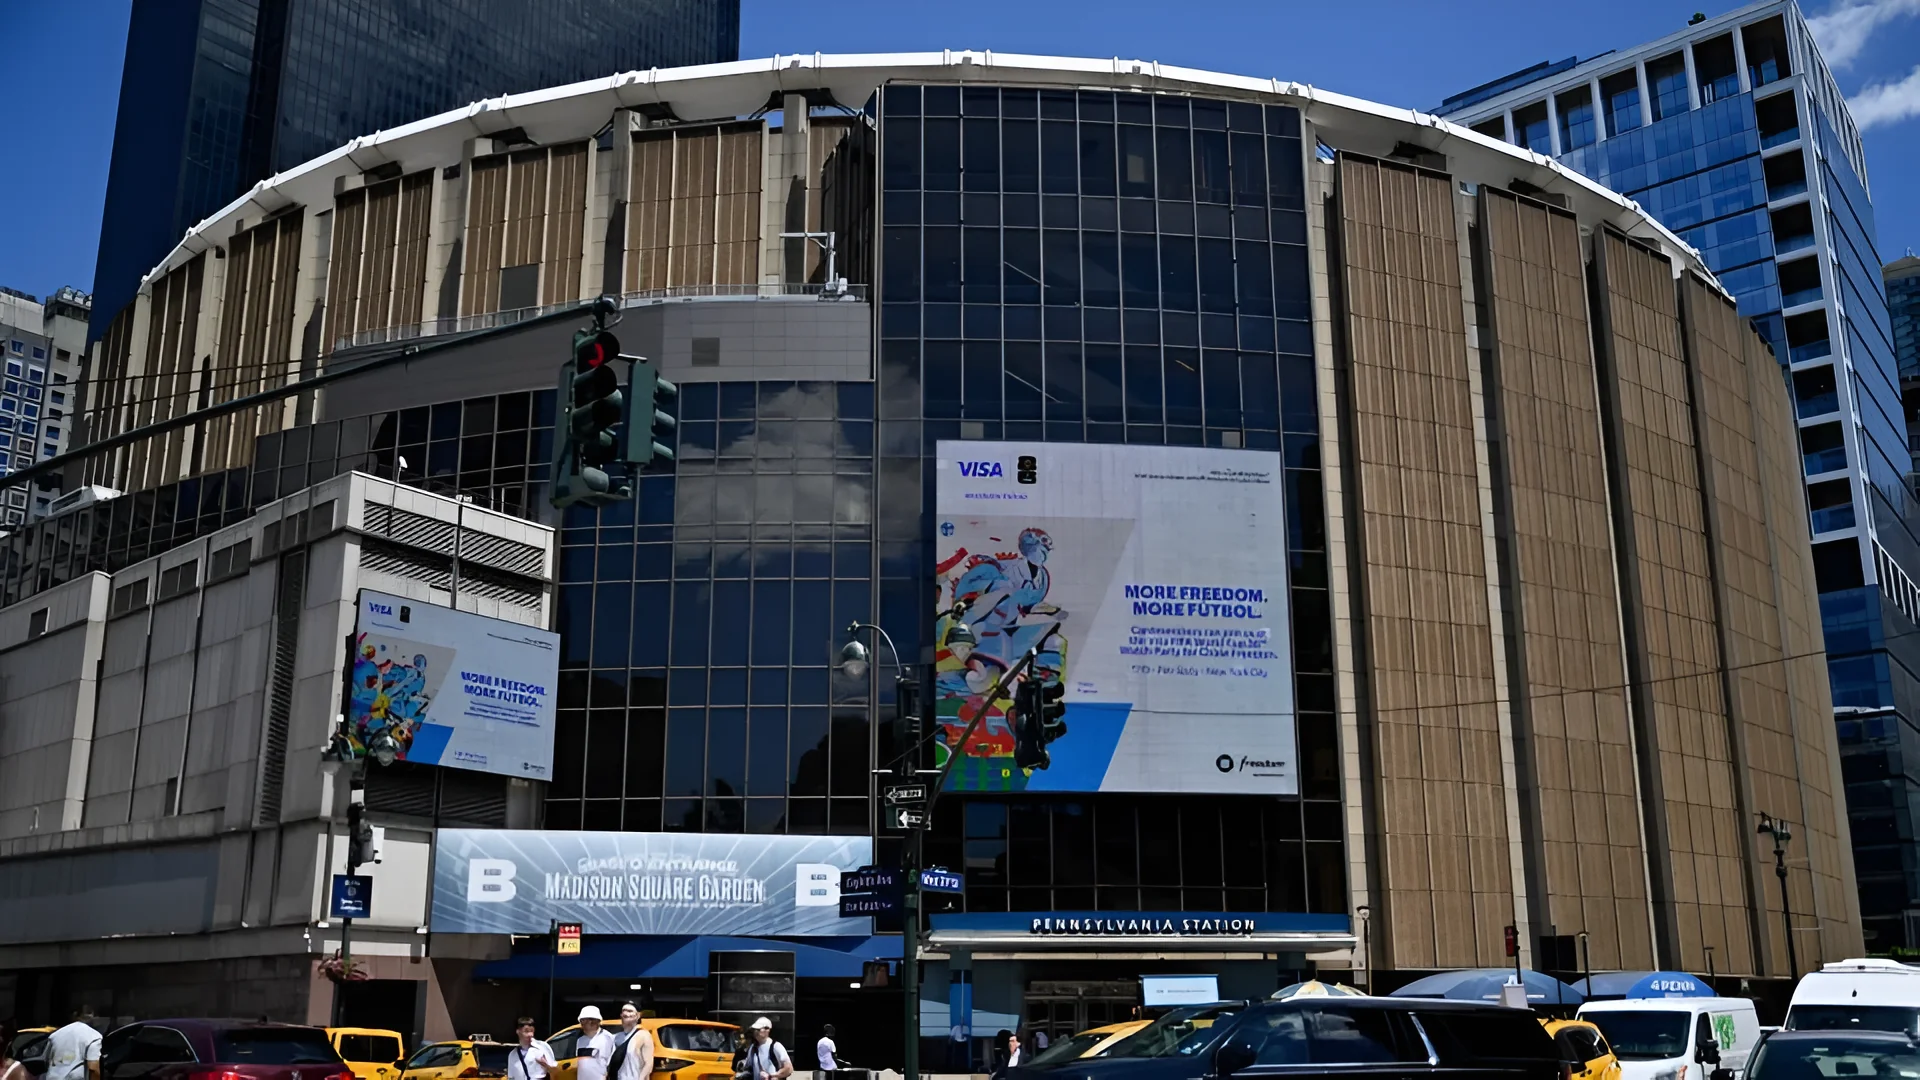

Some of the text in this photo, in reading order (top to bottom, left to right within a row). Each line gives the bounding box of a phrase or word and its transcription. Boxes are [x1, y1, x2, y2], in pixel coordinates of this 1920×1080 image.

[957, 461, 1003, 477] VISA
[1125, 585, 1268, 603] MORE FREEDOM.
[1133, 601, 1184, 616] MORE
[467, 858, 517, 903] B
[545, 872, 765, 902] MADISON SQUARE GARDEN
[796, 863, 841, 906] B
[1033, 918, 1255, 931] PENNSYLVANIA STATION
